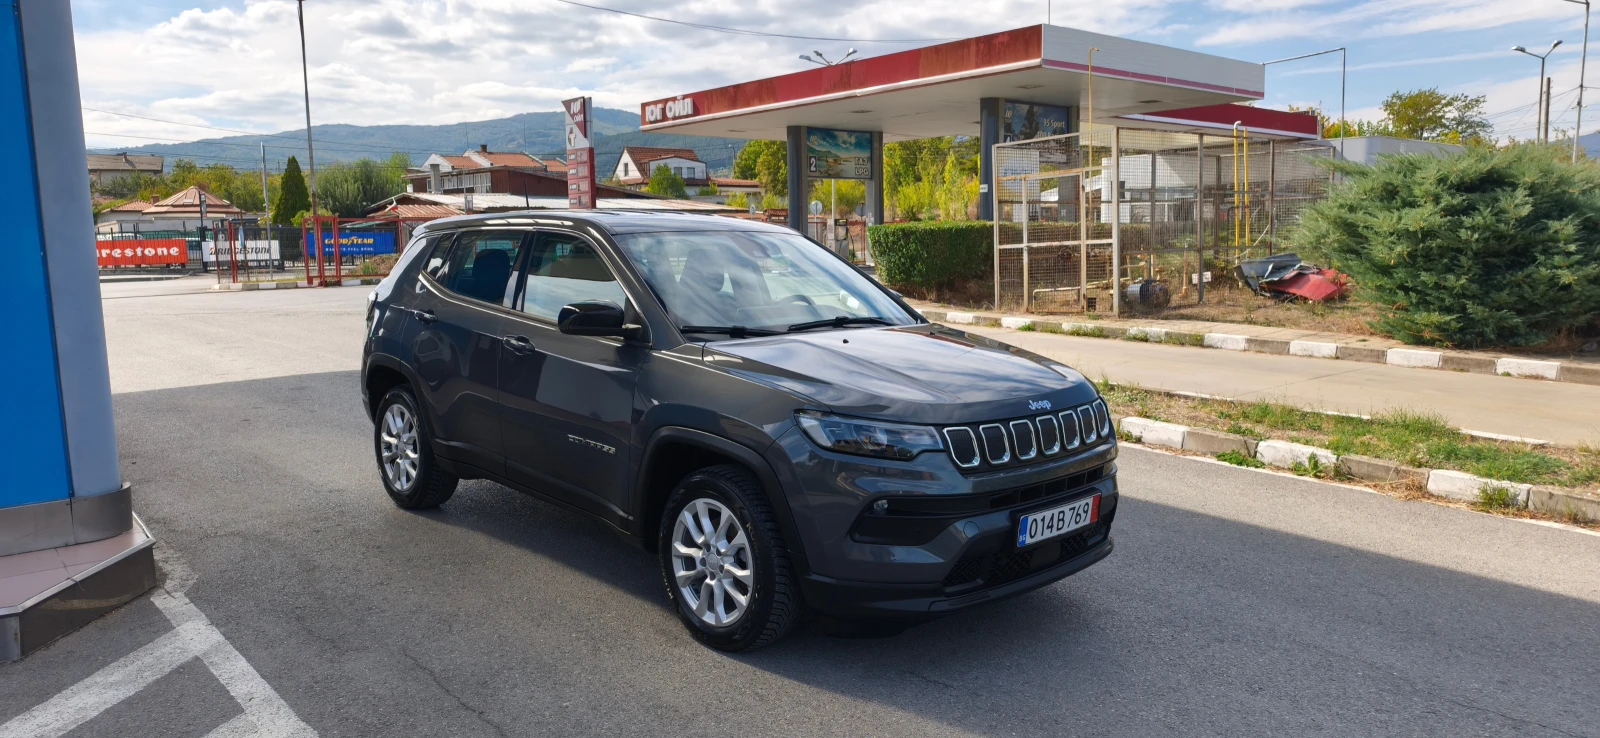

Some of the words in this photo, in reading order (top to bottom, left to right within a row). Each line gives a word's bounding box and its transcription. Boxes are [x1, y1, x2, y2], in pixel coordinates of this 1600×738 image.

[645, 104, 664, 122] ЮГ
[665, 95, 694, 119] ОЙЛ
[1050, 119, 1065, 129] Sport
[810, 157, 816, 171] 2
[854, 166, 869, 176] LPG
[1028, 400, 1051, 410] Jeep
[1029, 502, 1090, 539] 014B769
